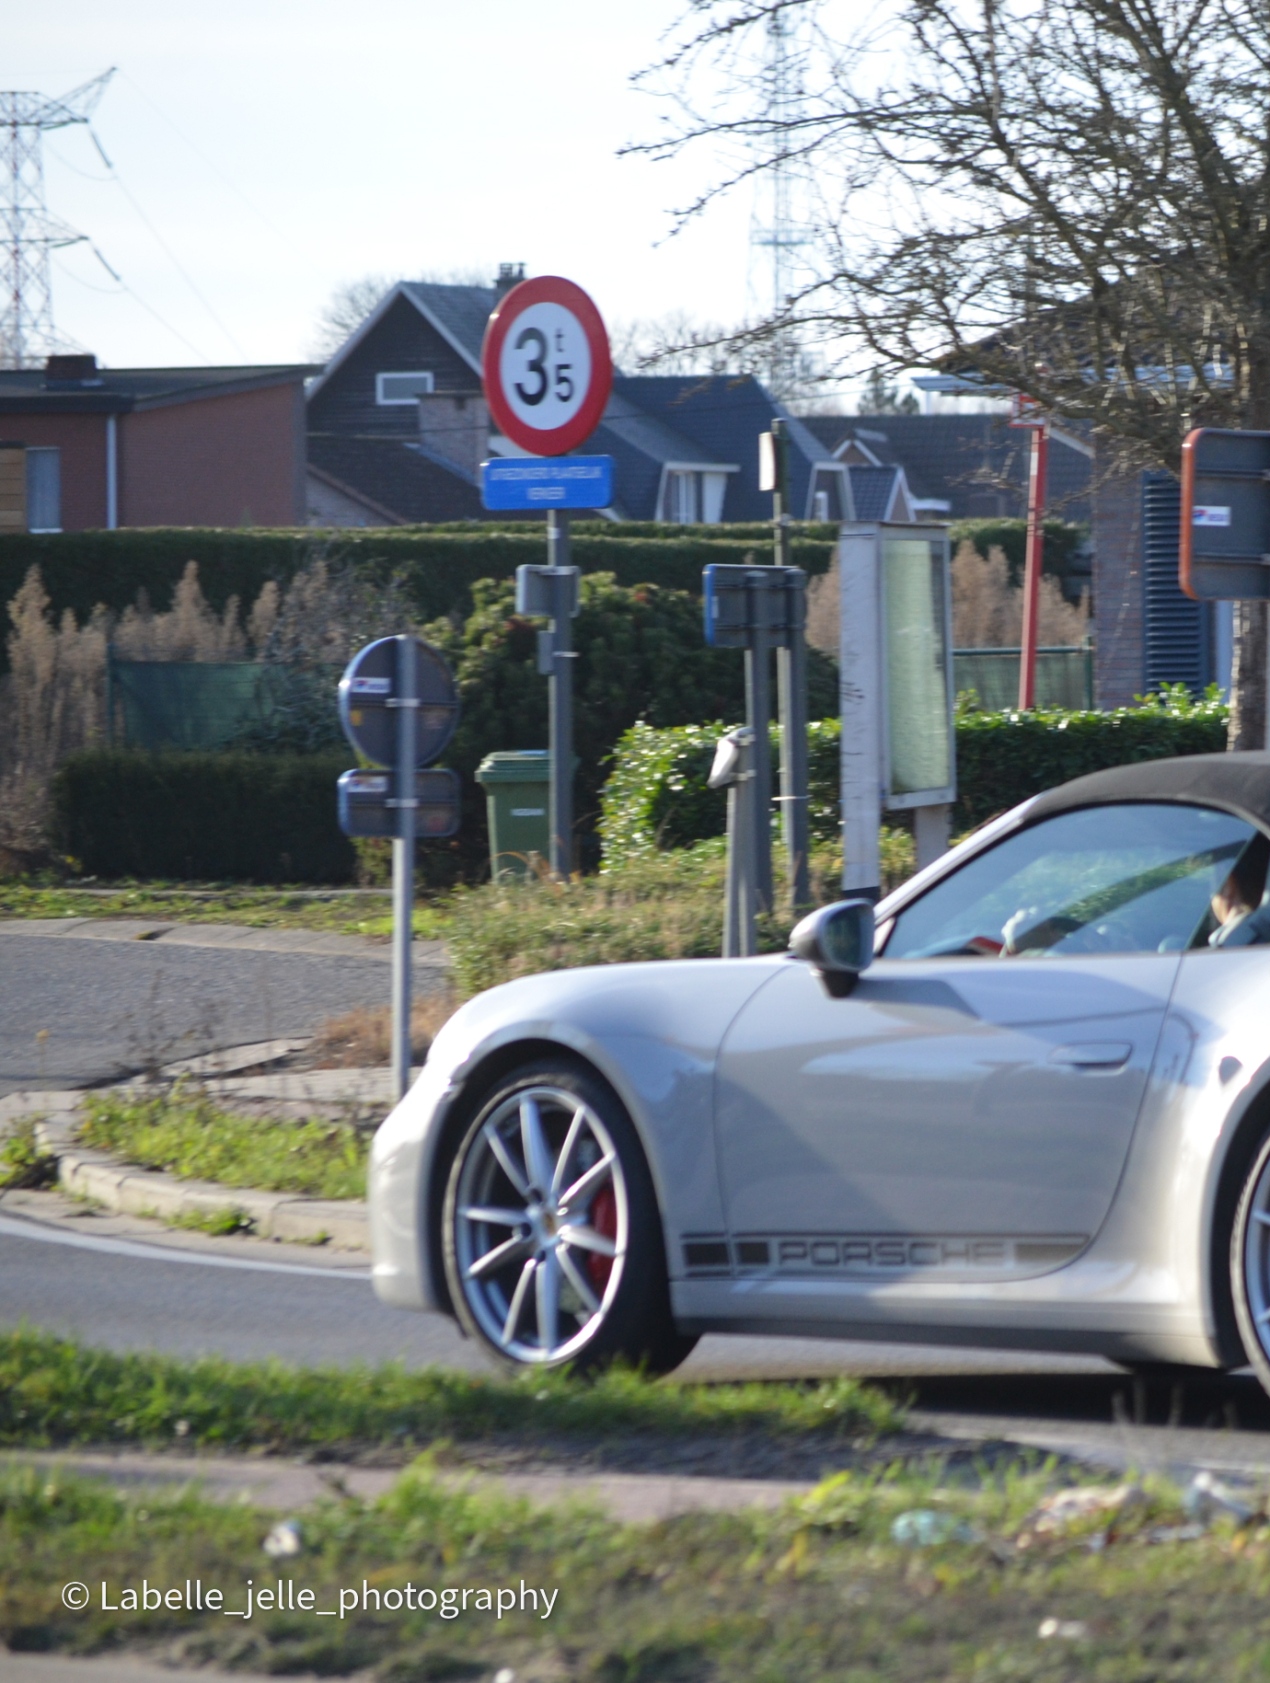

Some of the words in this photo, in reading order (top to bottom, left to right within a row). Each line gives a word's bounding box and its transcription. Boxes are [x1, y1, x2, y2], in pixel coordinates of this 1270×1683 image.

[514, 327, 548, 406] 3
[555, 364, 574, 402] 5
[779, 1240, 1004, 1267] PORSCHE
